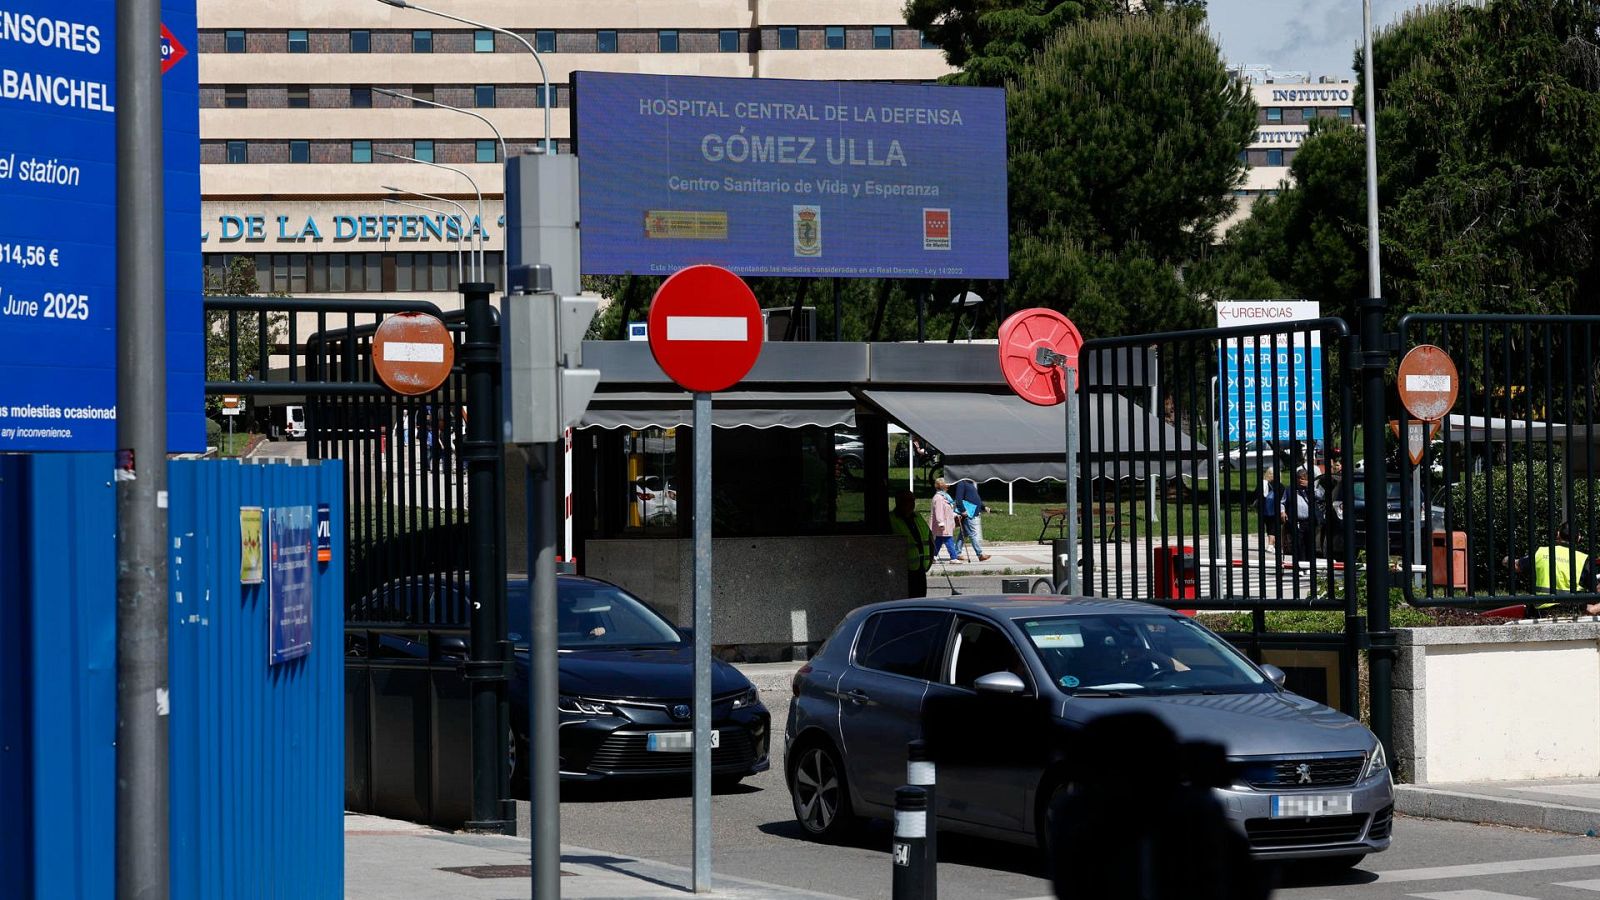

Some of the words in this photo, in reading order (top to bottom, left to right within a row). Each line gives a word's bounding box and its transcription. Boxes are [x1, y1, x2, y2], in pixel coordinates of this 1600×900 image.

[0, 11, 101, 55] NSORES
[0, 69, 115, 113] BANCHEL
[1272, 89, 1349, 102] INSTITUTO
[639, 98, 730, 118] HOSPITAL
[734, 102, 820, 121] CENTRAL
[824, 105, 849, 122] DE
[854, 106, 877, 123] LA
[881, 107, 963, 126] DEFENSA
[701, 125, 817, 164] GÓMEZ
[825, 137, 908, 167] ULLA
[18, 157, 80, 186] station
[668, 175, 720, 191] Centro
[723, 177, 790, 193] Sanitario
[794, 178, 812, 193] de
[816, 179, 849, 195] Vida
[852, 183, 861, 198] y
[865, 180, 940, 199] Esperanza
[219, 214, 268, 242] DE
[276, 214, 324, 242] LA
[333, 214, 490, 242] DEFENSA
[49, 248, 59, 267] €
[3, 294, 39, 317] June
[43, 292, 89, 321] 2025
[1231, 306, 1293, 319] URGENCIAS
[10, 403, 62, 419] molestias
[1, 427, 16, 440] any
[16, 426, 73, 438] inconvenience.
